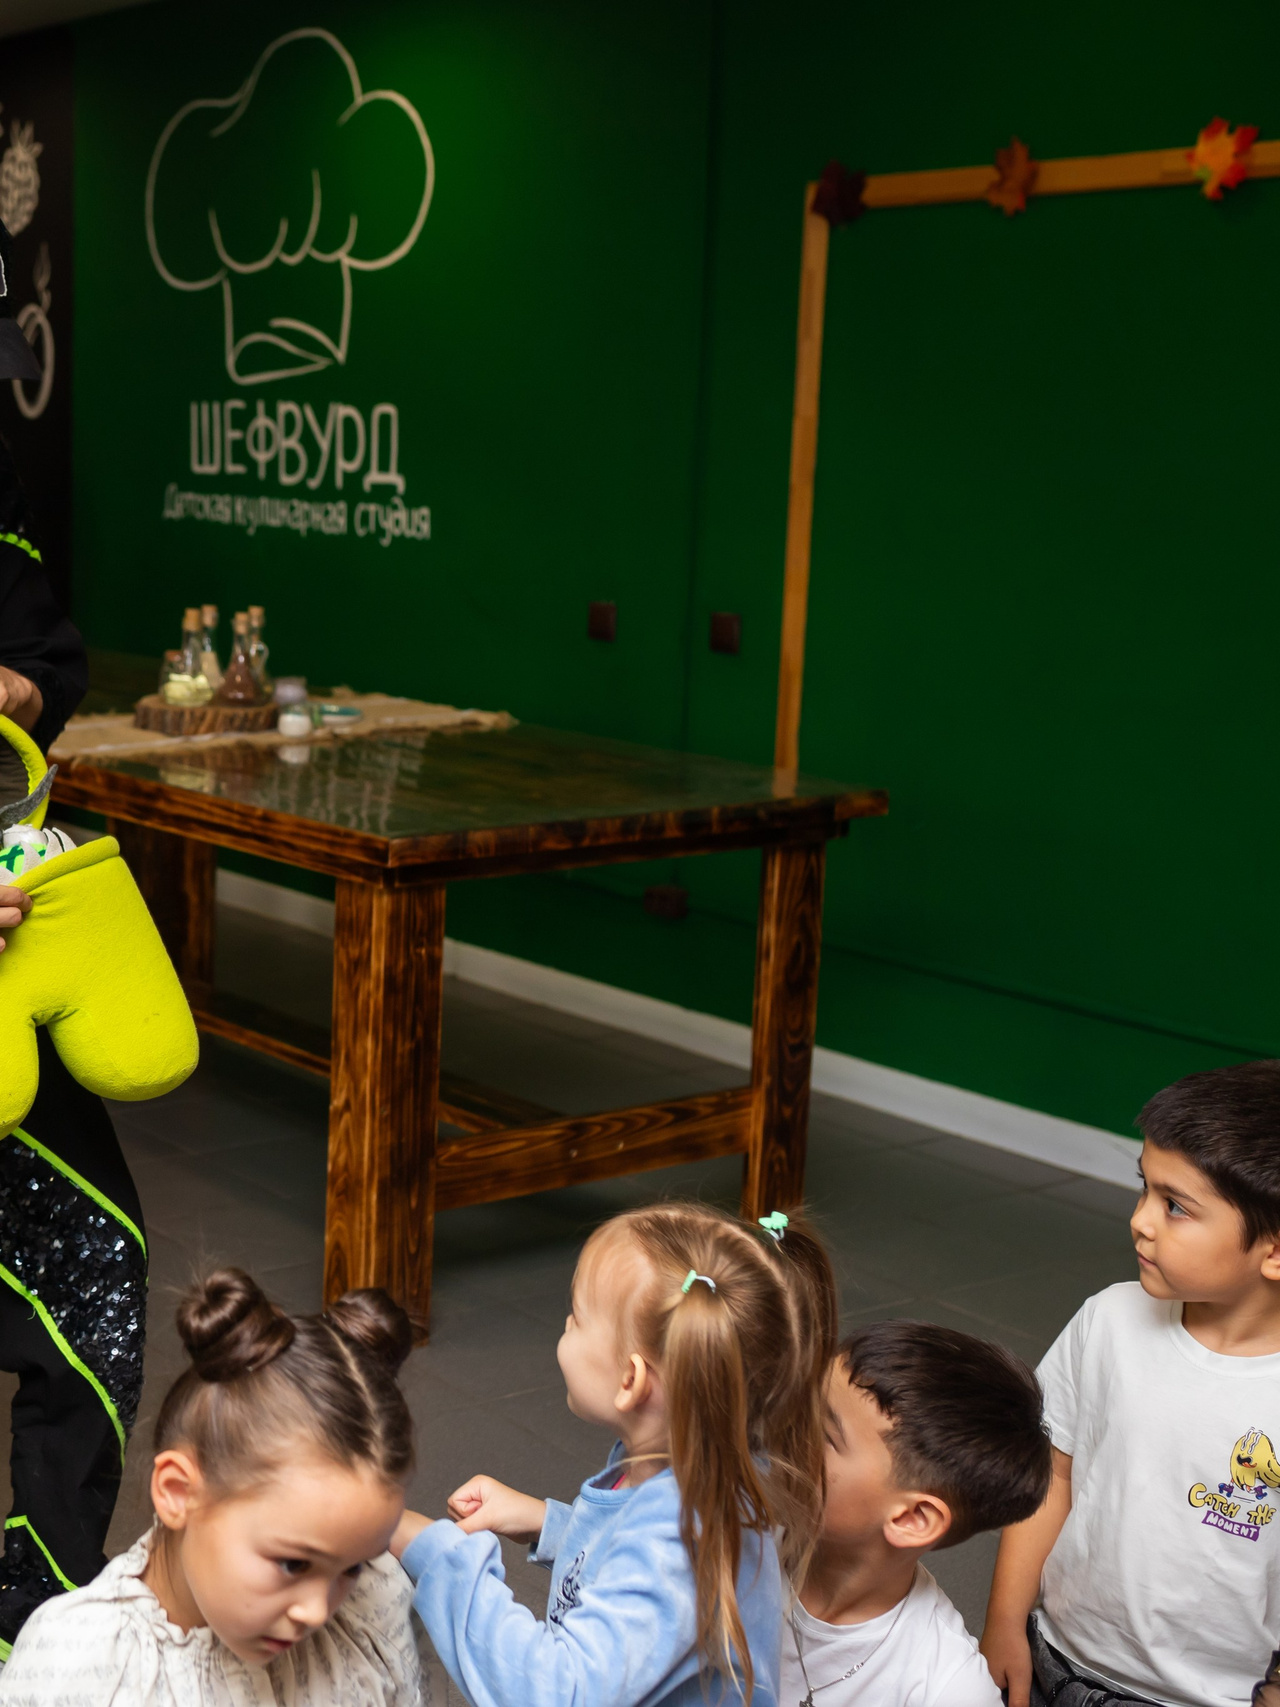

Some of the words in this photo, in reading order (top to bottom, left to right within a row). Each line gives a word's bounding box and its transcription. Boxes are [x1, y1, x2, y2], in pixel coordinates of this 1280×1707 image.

[190, 398, 406, 495] ШЕФВУРД
[162, 483, 232, 524] Детская
[234, 494, 348, 537] кулинарная
[354, 496, 432, 548] студия
[1188, 1482, 1241, 1518] CATCH
[1247, 1504, 1277, 1526] THE
[1205, 1512, 1258, 1539] MOMENT
